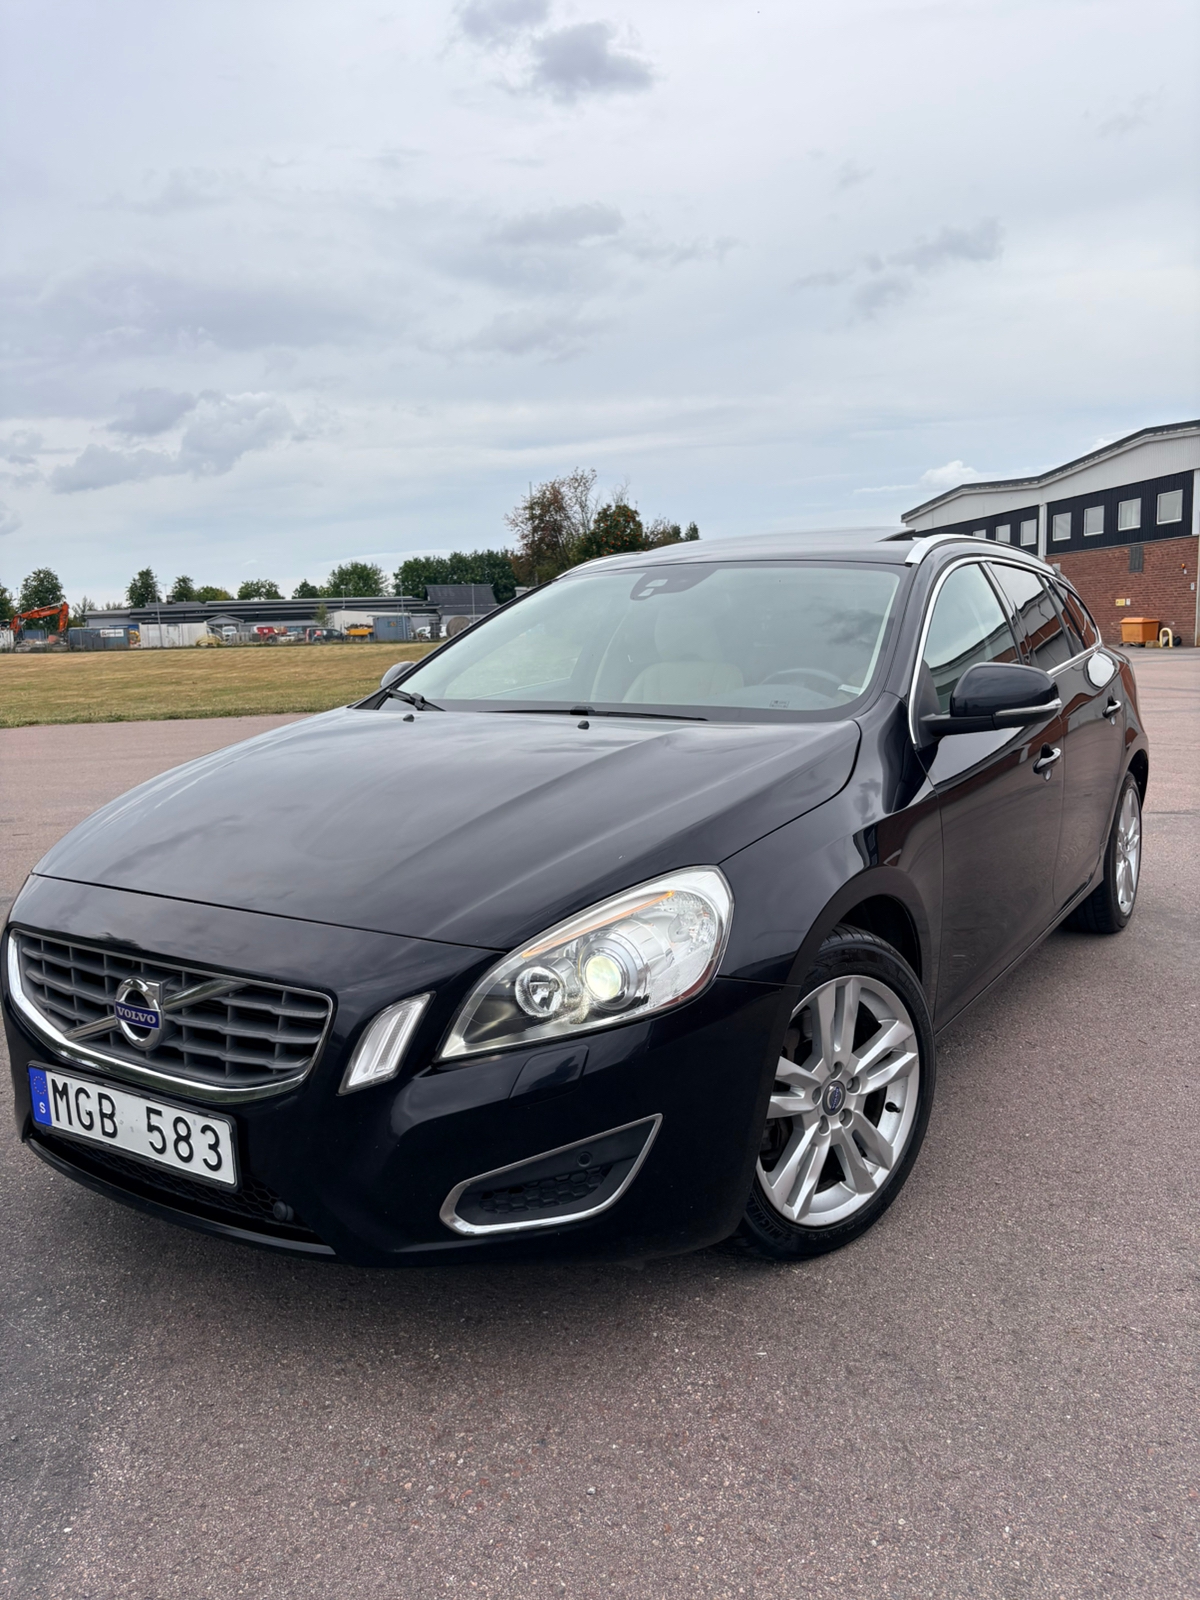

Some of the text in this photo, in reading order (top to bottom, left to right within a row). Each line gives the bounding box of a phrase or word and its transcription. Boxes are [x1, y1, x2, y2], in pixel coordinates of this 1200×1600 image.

[116, 1005, 156, 1024] VOLVO
[39, 1101, 46, 1114] S
[51, 1078, 223, 1172] MGB 583
[746, 1192, 784, 1239] MICHEL
